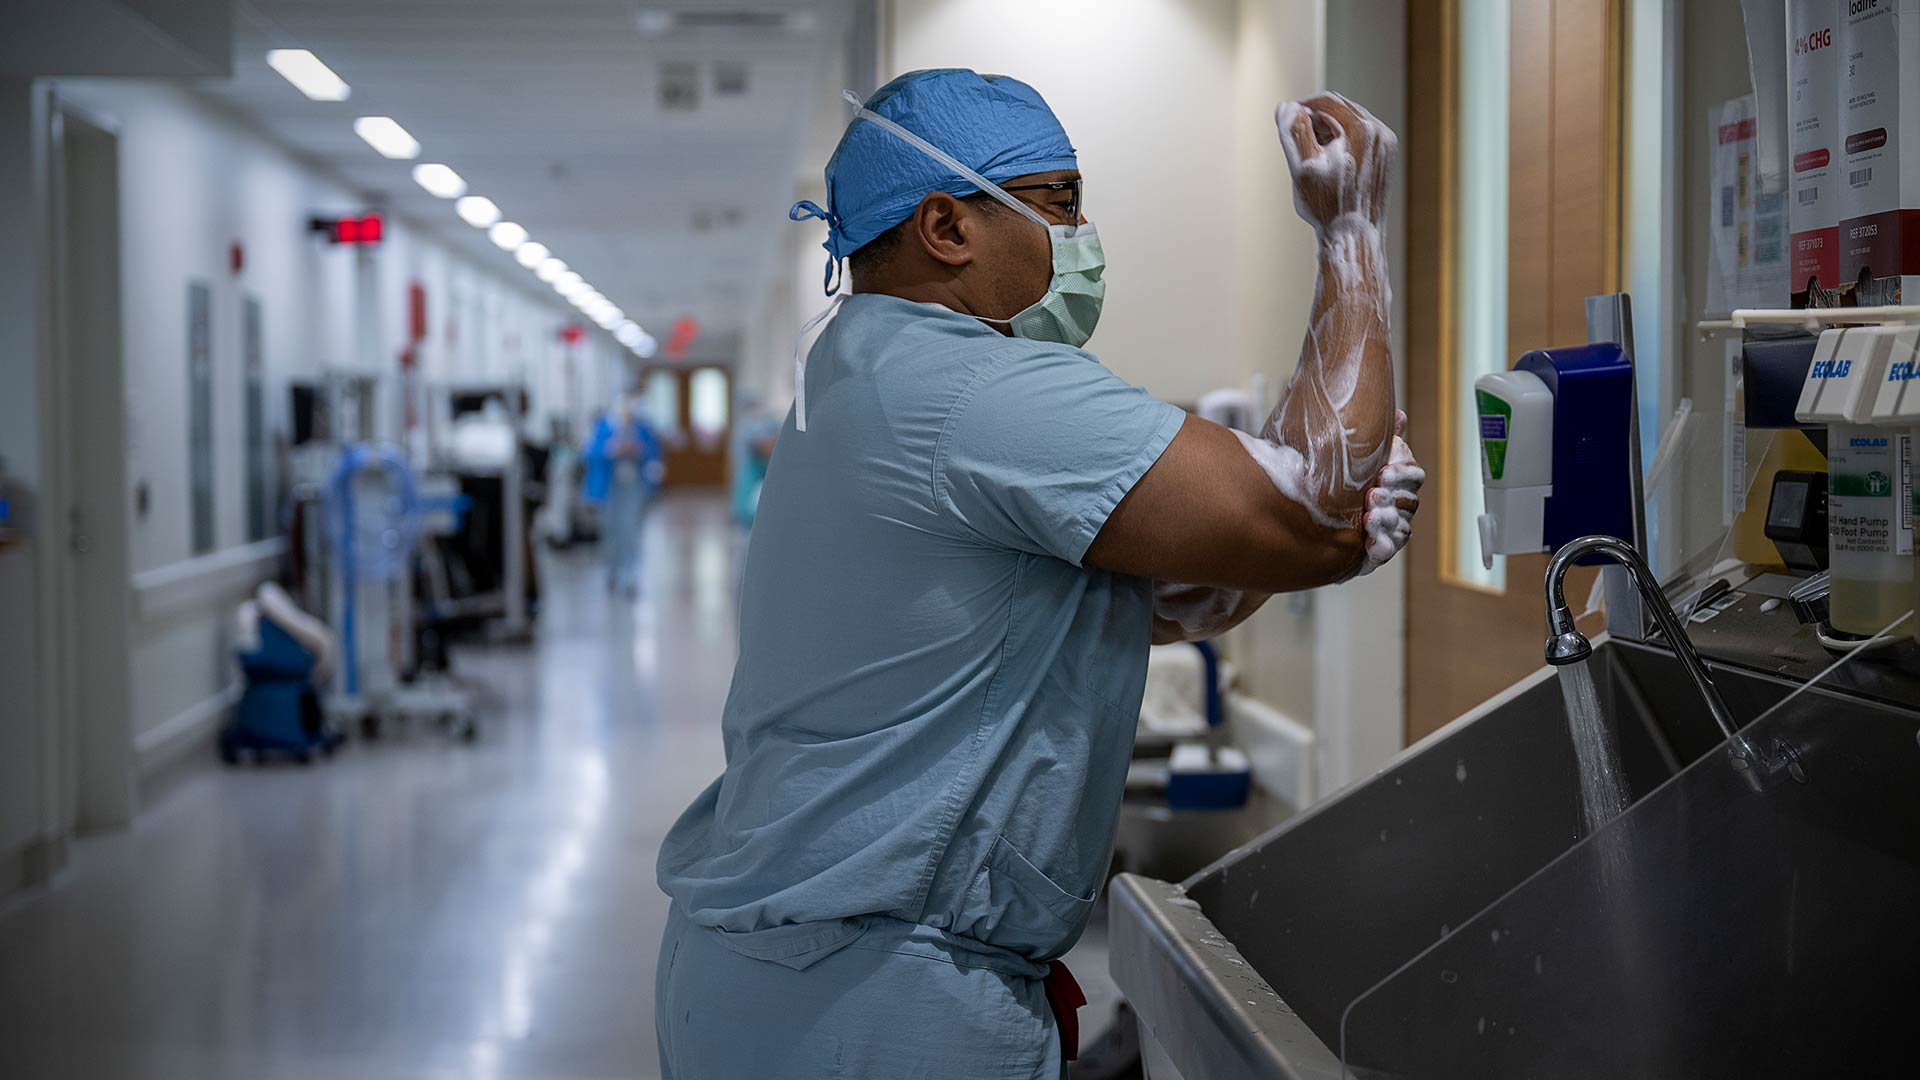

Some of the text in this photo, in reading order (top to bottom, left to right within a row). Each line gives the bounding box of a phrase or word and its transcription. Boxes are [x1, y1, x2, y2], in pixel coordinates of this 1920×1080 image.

[1808, 28, 1831, 51] CHG
[1849, 228, 1858, 239] REF
[1798, 240, 1806, 251] REF
[1811, 360, 1852, 379] ECOLAB
[1849, 438, 1888, 447] ECOLAB
[1838, 516, 1858, 526] Hand
[1860, 517, 1889, 528] Pump
[1841, 526, 1858, 536] Foot
[1860, 527, 1889, 539] Pump
